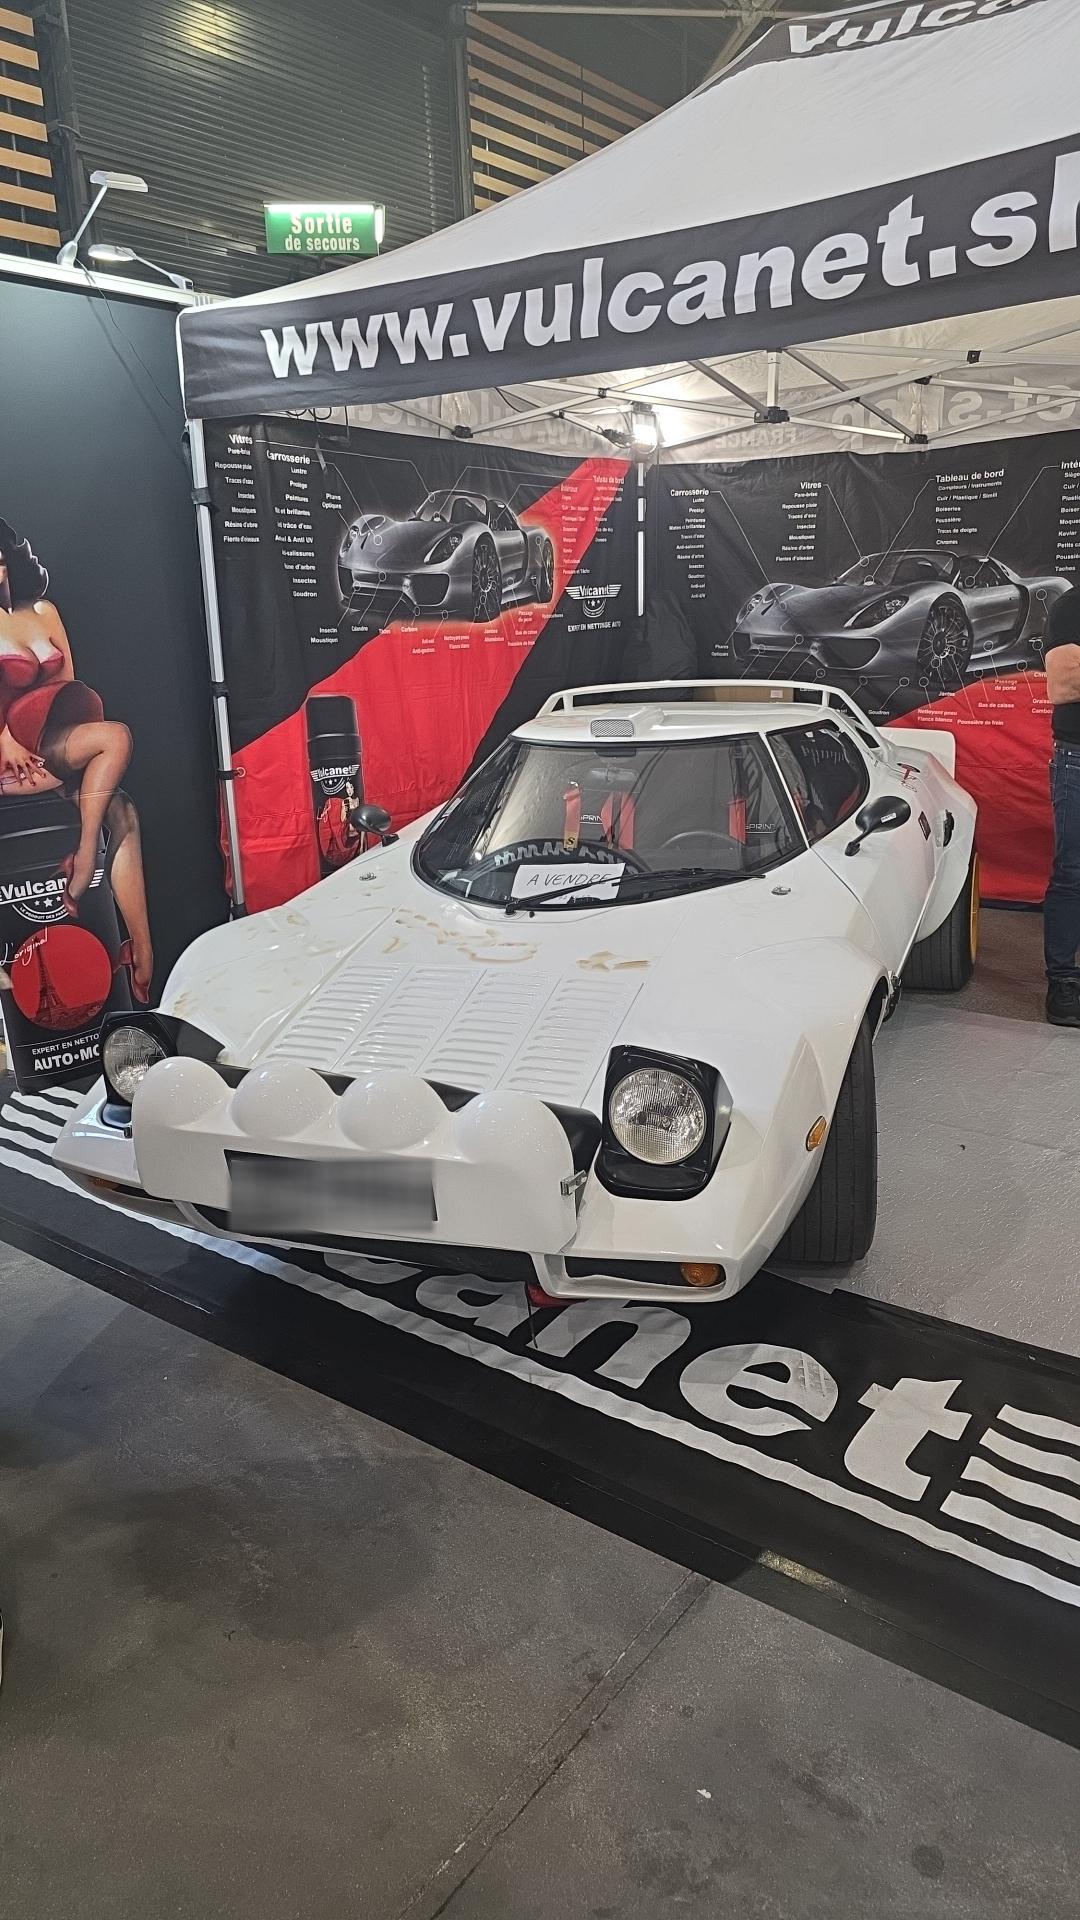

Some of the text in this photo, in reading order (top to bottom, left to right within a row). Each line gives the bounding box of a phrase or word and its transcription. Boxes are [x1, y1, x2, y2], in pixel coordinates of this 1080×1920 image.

[291, 211, 353, 234] Sortie
[284, 233, 360, 251] de secours
[229, 434, 253, 444] Vitres
[266, 449, 311, 464] Carrosserie
[936, 469, 1004, 483] Tableau de bord
[670, 488, 709, 497] Carrosserie
[580, 814, 603, 822] PRIN
[527, 873, 612, 886] A VENDRE
[26, 911, 45, 920] PRODUIT
[0, 925, 48, 966] L'original
[32, 1043, 60, 1055] EXPERT
[62, 1041, 73, 1050] EN
